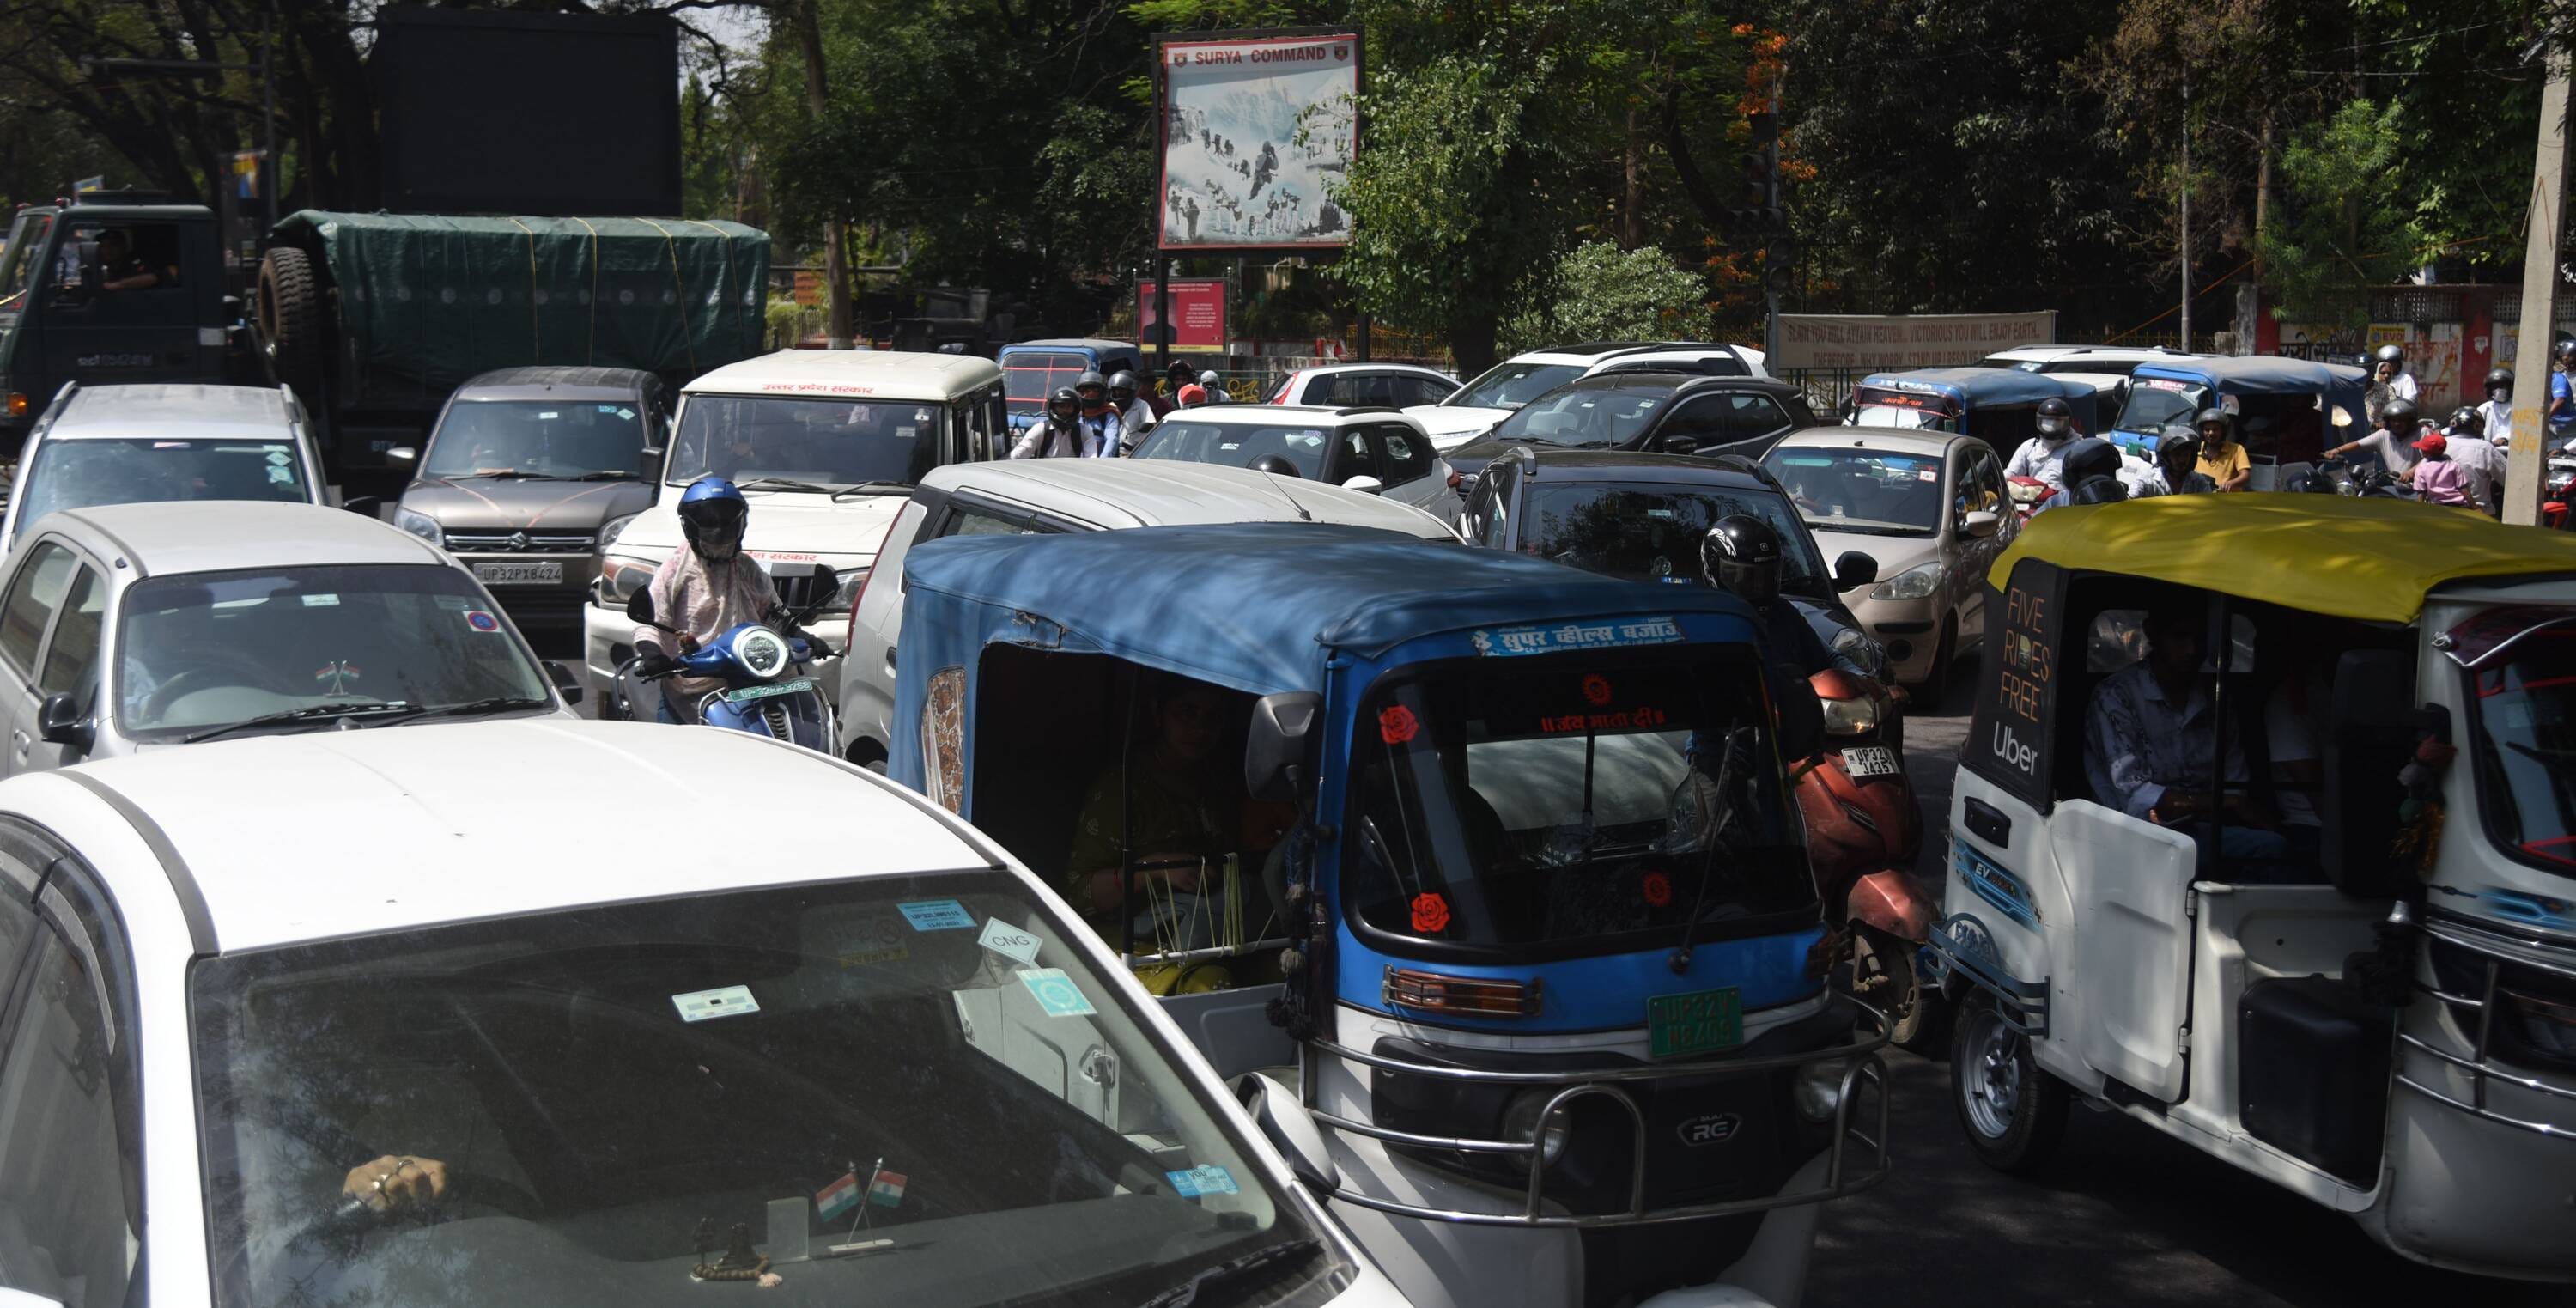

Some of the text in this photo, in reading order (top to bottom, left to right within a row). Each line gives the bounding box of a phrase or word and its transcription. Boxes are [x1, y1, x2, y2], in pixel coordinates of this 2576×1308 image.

[1195, 46, 1327, 65] SURYA COMMAND
[1811, 325, 1826, 343] YOU
[1827, 325, 1845, 344] WILL
[1846, 324, 1872, 344] ATTAIN
[1910, 323, 1952, 343] VICTORIOUS
[1955, 323, 1969, 342] YOU
[1971, 323, 1987, 341] WILL
[1989, 322, 2011, 340] ENJOY
[1860, 352, 1876, 368] WHY
[1878, 351, 1904, 368] WORRY
[1909, 351, 1931, 366] STAND
[799, 382, 828, 392] प्रदेश
[831, 385, 874, 394] सरकार
[770, 553, 817, 562] सरकार
[2007, 587, 2045, 634] FIVE
[1498, 630, 1547, 653] सुपर
[1552, 624, 1614, 644] व्हील्स
[2003, 629, 2050, 683] RIDES
[1999, 672, 2041, 722] FREE
[1993, 721, 2038, 776] Uber
[1975, 861, 1990, 878] EV
[992, 935, 1030, 947] CNG
[1692, 1121, 1729, 1141] RE
[1188, 1170, 1207, 1180] you
